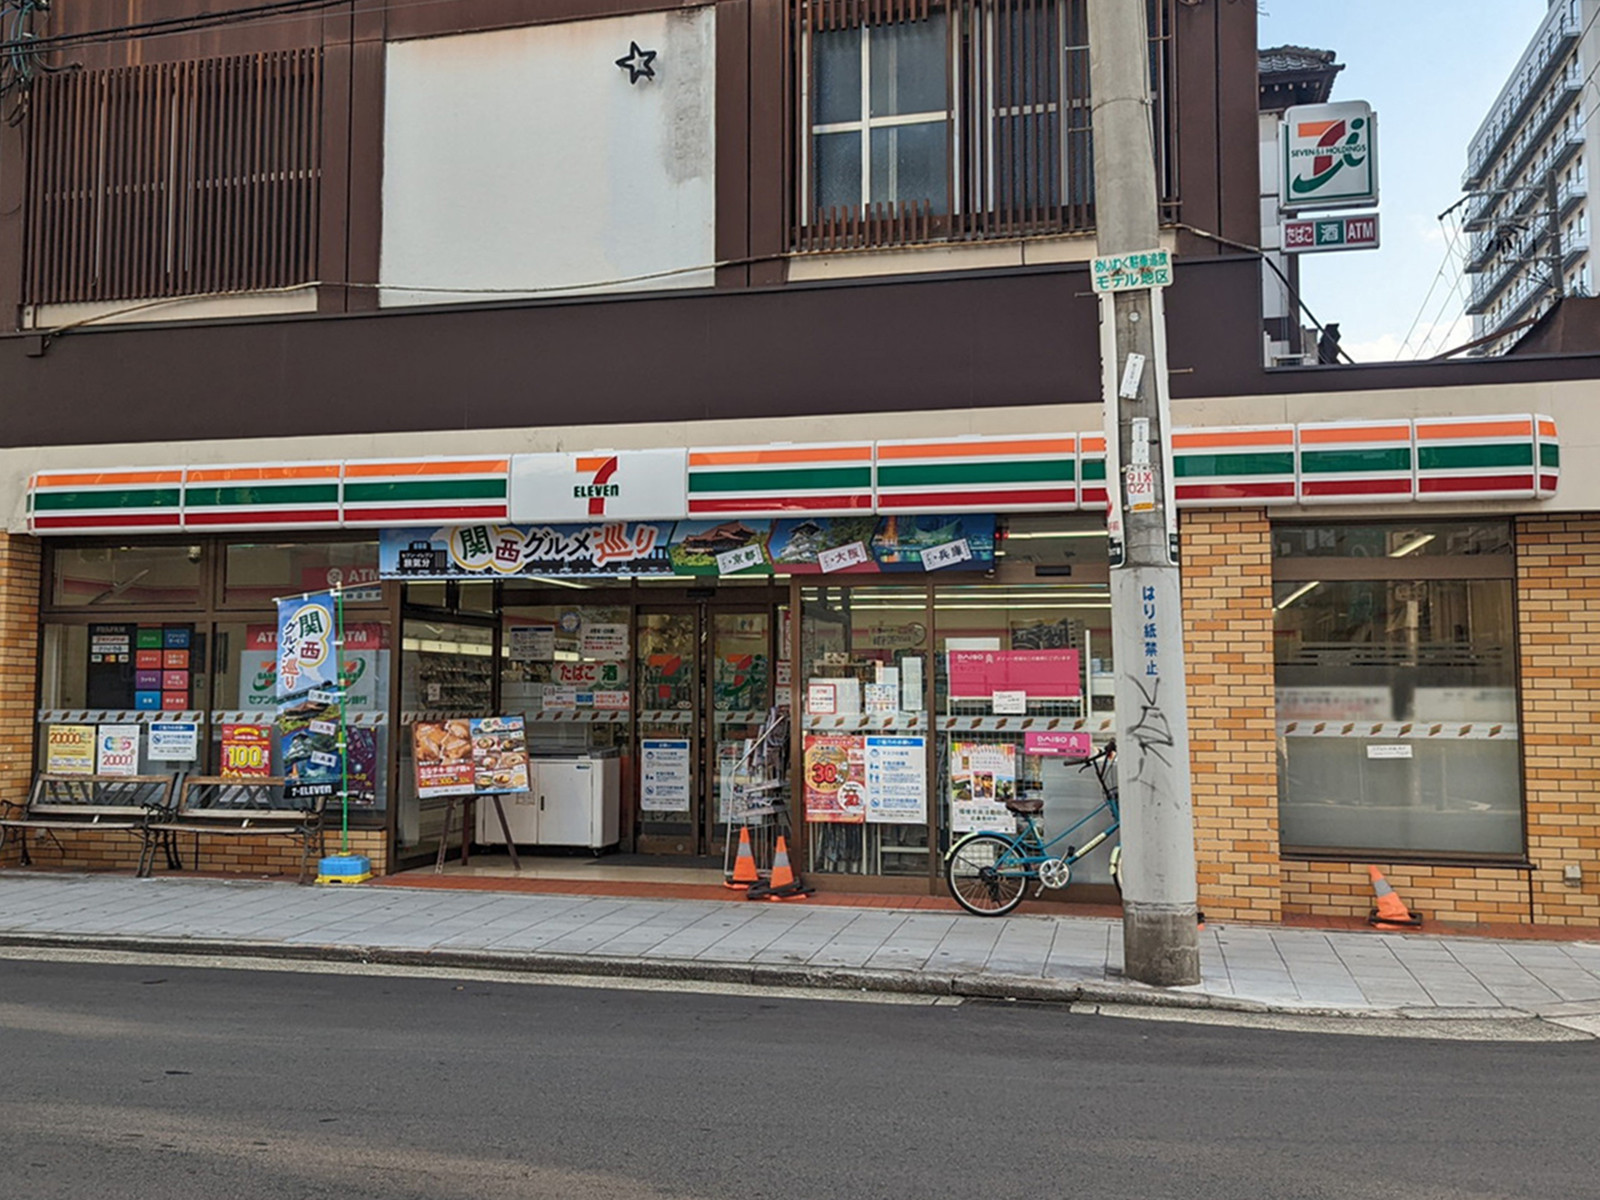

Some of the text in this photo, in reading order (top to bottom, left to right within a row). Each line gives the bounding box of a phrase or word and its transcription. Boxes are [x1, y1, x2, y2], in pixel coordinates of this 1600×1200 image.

[1286, 225, 1314, 244] たばこ
[1321, 222, 1339, 242] 酒
[1347, 221, 1374, 240] ATM
[1096, 268, 1169, 290] モデル地区
[458, 522, 656, 563] 関西グルメ巡り
[256, 632, 278, 643] AT
[1142, 585, 1158, 676] はり紙禁止
[561, 665, 595, 681] たばこ
[602, 665, 617, 681] 酒
[50, 732, 81, 744] 20000
[102, 755, 133, 766] 20000
